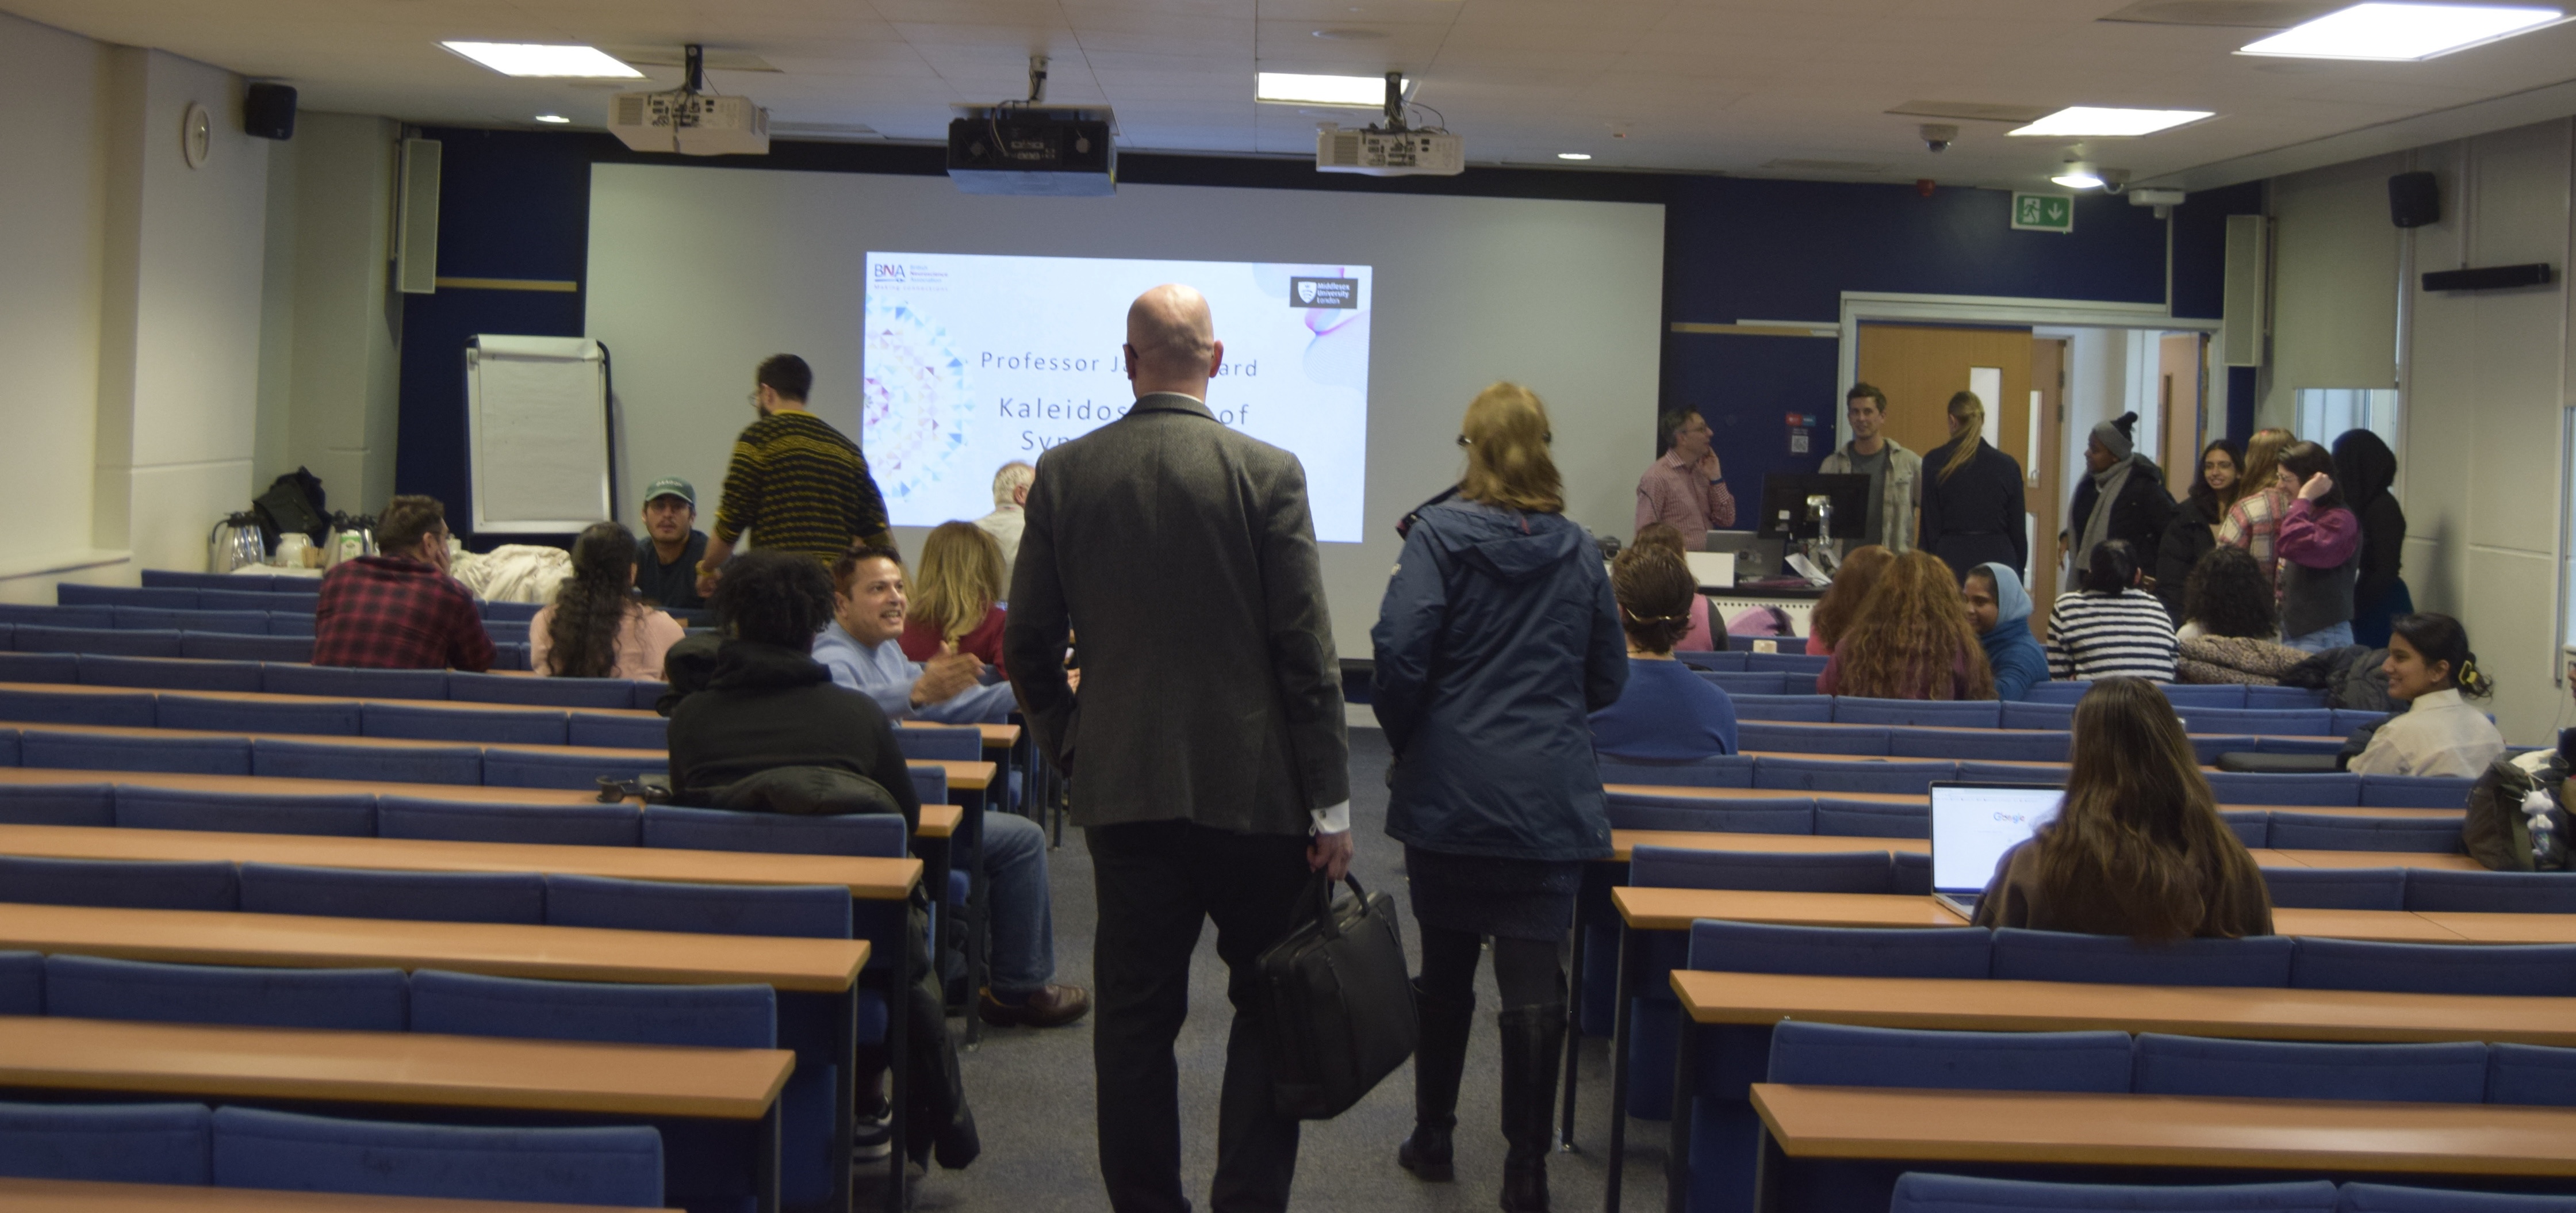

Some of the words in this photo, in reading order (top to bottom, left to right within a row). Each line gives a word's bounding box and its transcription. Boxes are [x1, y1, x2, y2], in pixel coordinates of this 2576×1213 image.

[875, 264, 905, 278] BNA
[1317, 282, 1350, 290] Middlesex
[1317, 290, 1349, 299] University
[981, 351, 1099, 372] Professor
[1110, 355, 1128, 373] J
[1218, 359, 1257, 377] ard
[999, 397, 1128, 422] Kaleidos
[1220, 404, 1249, 425] of
[1021, 430, 1070, 451] Syn
[1993, 812, 2025, 824] Google
